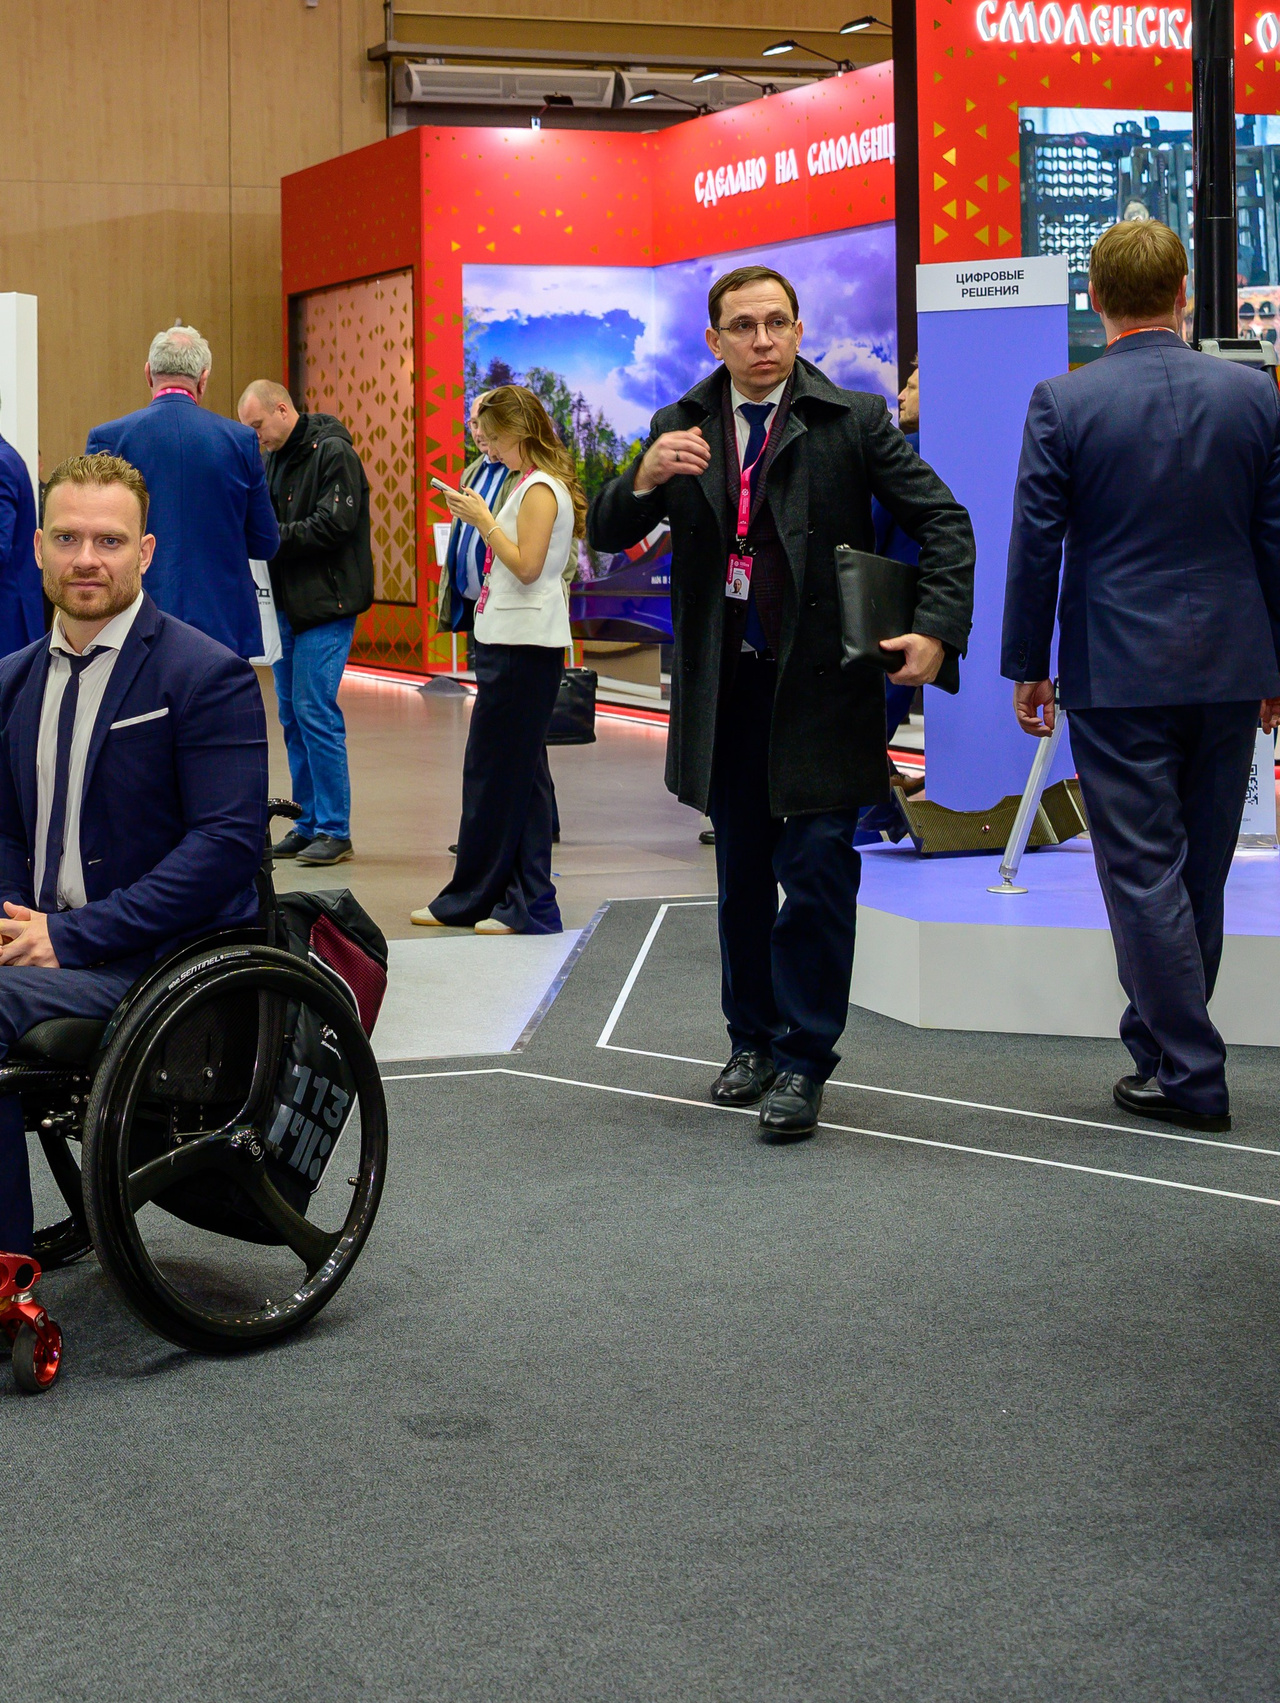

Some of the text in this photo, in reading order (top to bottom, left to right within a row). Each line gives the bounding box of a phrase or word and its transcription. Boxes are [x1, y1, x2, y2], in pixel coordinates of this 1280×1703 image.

[976, 0, 1192, 50] СМОЛЕНСК
[694, 122, 894, 208] СДЕЛАНО НА СМОЛЕНЩ
[956, 269, 1025, 285] ЦИФРОВЫЕ
[961, 285, 1019, 298] РЕШЕНИЯ
[180, 955, 221, 981] SENTINEL
[292, 1064, 350, 1128] 113
